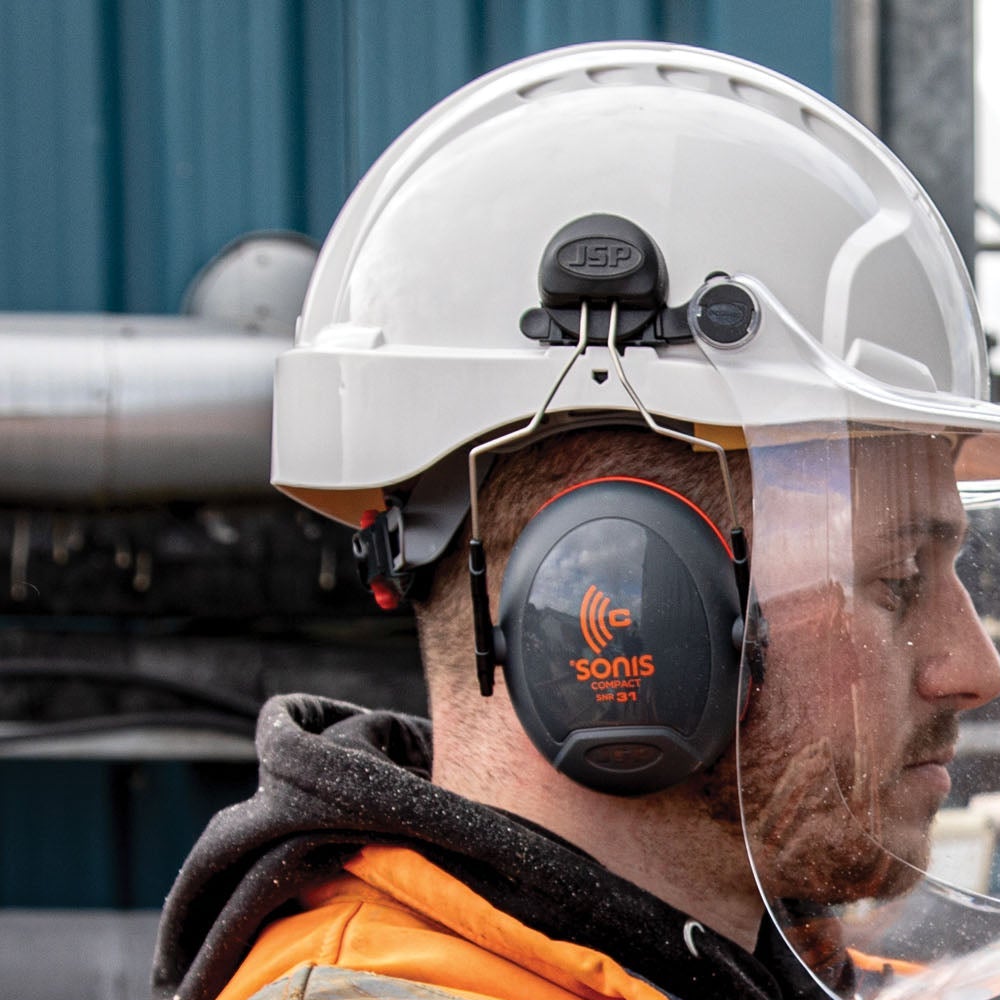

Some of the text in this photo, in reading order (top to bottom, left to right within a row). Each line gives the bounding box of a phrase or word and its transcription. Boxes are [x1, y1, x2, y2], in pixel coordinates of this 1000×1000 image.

[569, 246, 631, 267] JSP
[591, 679, 641, 690] COMPACT
[596, 691, 637, 703] SNR 31
